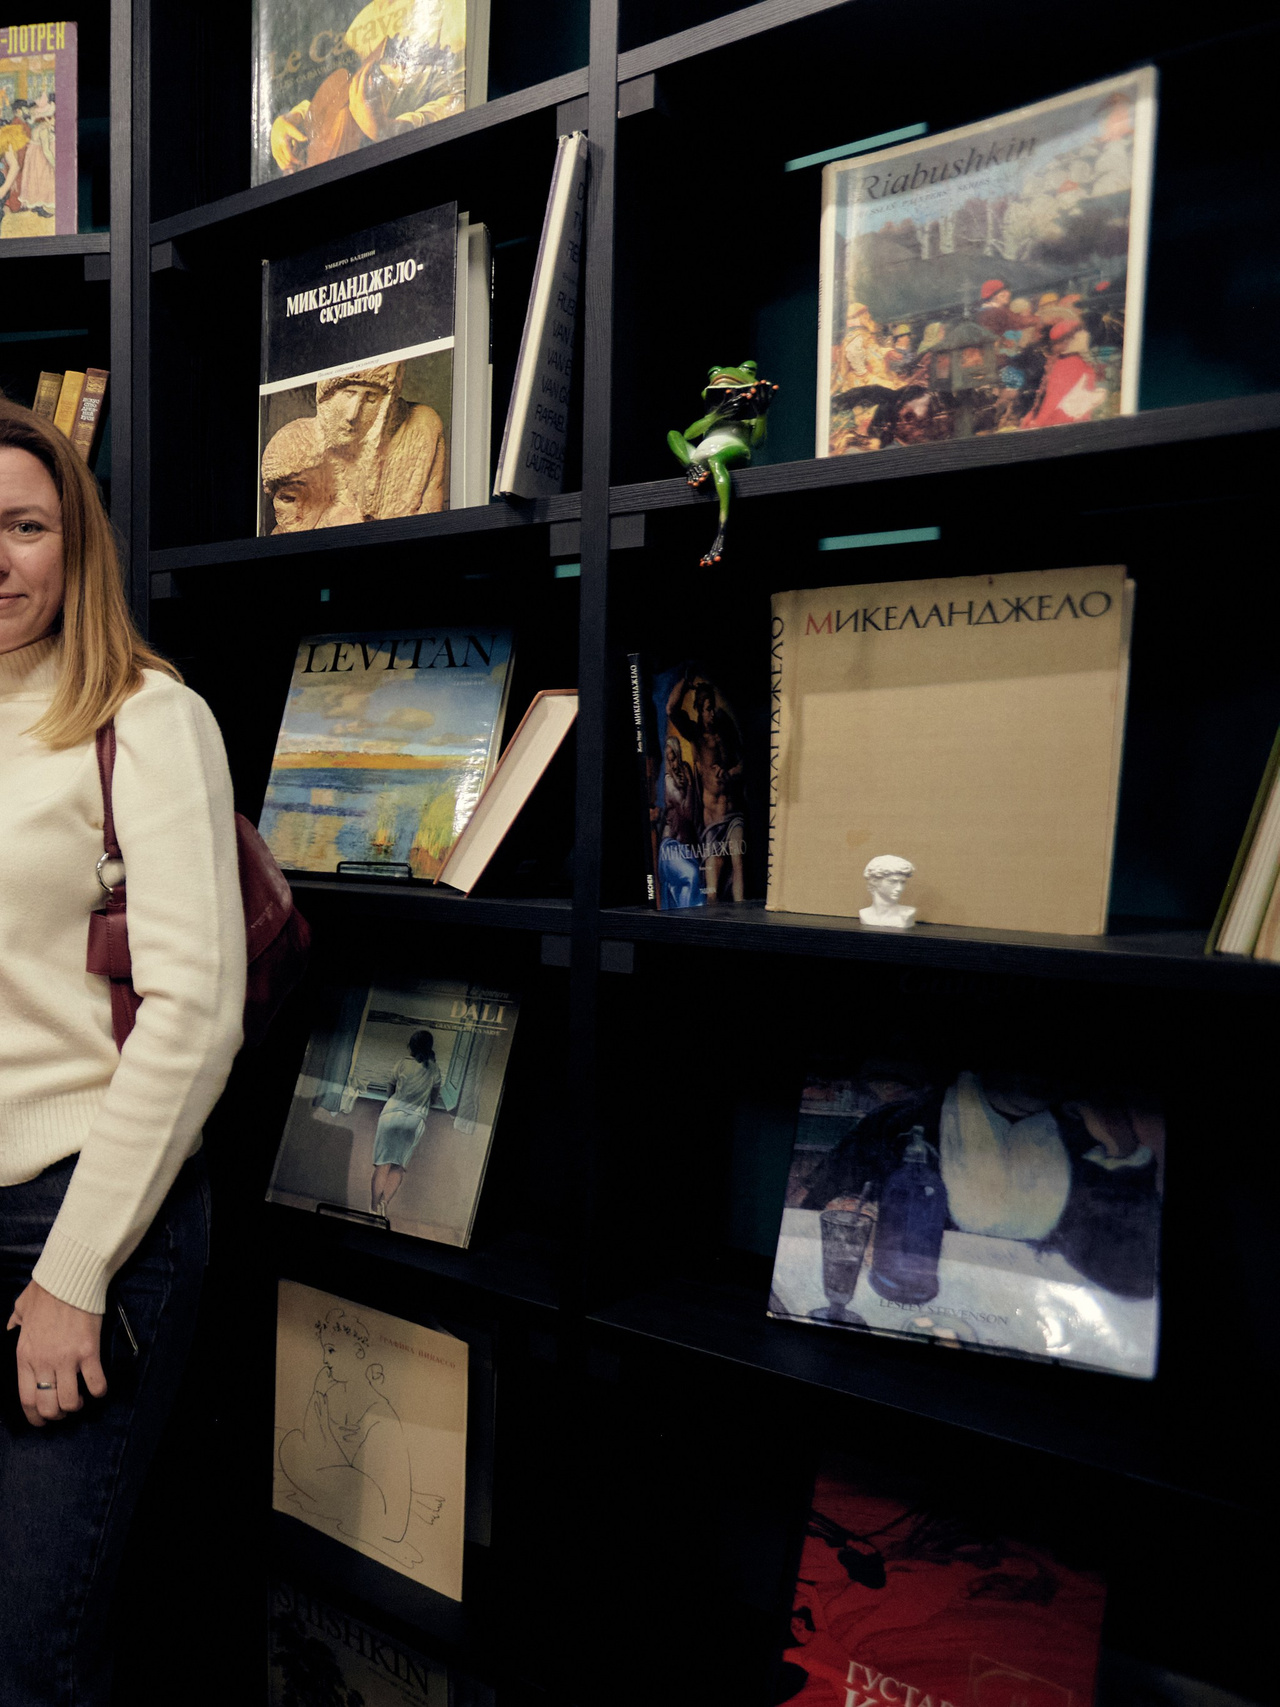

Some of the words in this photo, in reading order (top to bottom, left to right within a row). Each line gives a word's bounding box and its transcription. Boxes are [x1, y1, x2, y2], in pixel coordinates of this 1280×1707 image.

[862, 137, 1036, 200] Riabushkin
[286, 258, 424, 317] МИКЕЛАНДЖЕЛО-
[319, 292, 382, 324] скульптор
[531, 431, 565, 462] TOULOUS
[805, 591, 1113, 636] МИКЕЛАНДЖЕЛО
[301, 634, 497, 673] LEVITAN
[630, 664, 642, 726] МИКЕЛАНДЖЕЛО
[661, 840, 748, 861] МИКЕЛАНДЖЕЛО
[450, 999, 506, 1024] DALI
[880, 1298, 923, 1312] LESLEY
[927, 1305, 1008, 1325] STEVENSON
[380, 1335, 415, 1354] ГРАФИКА
